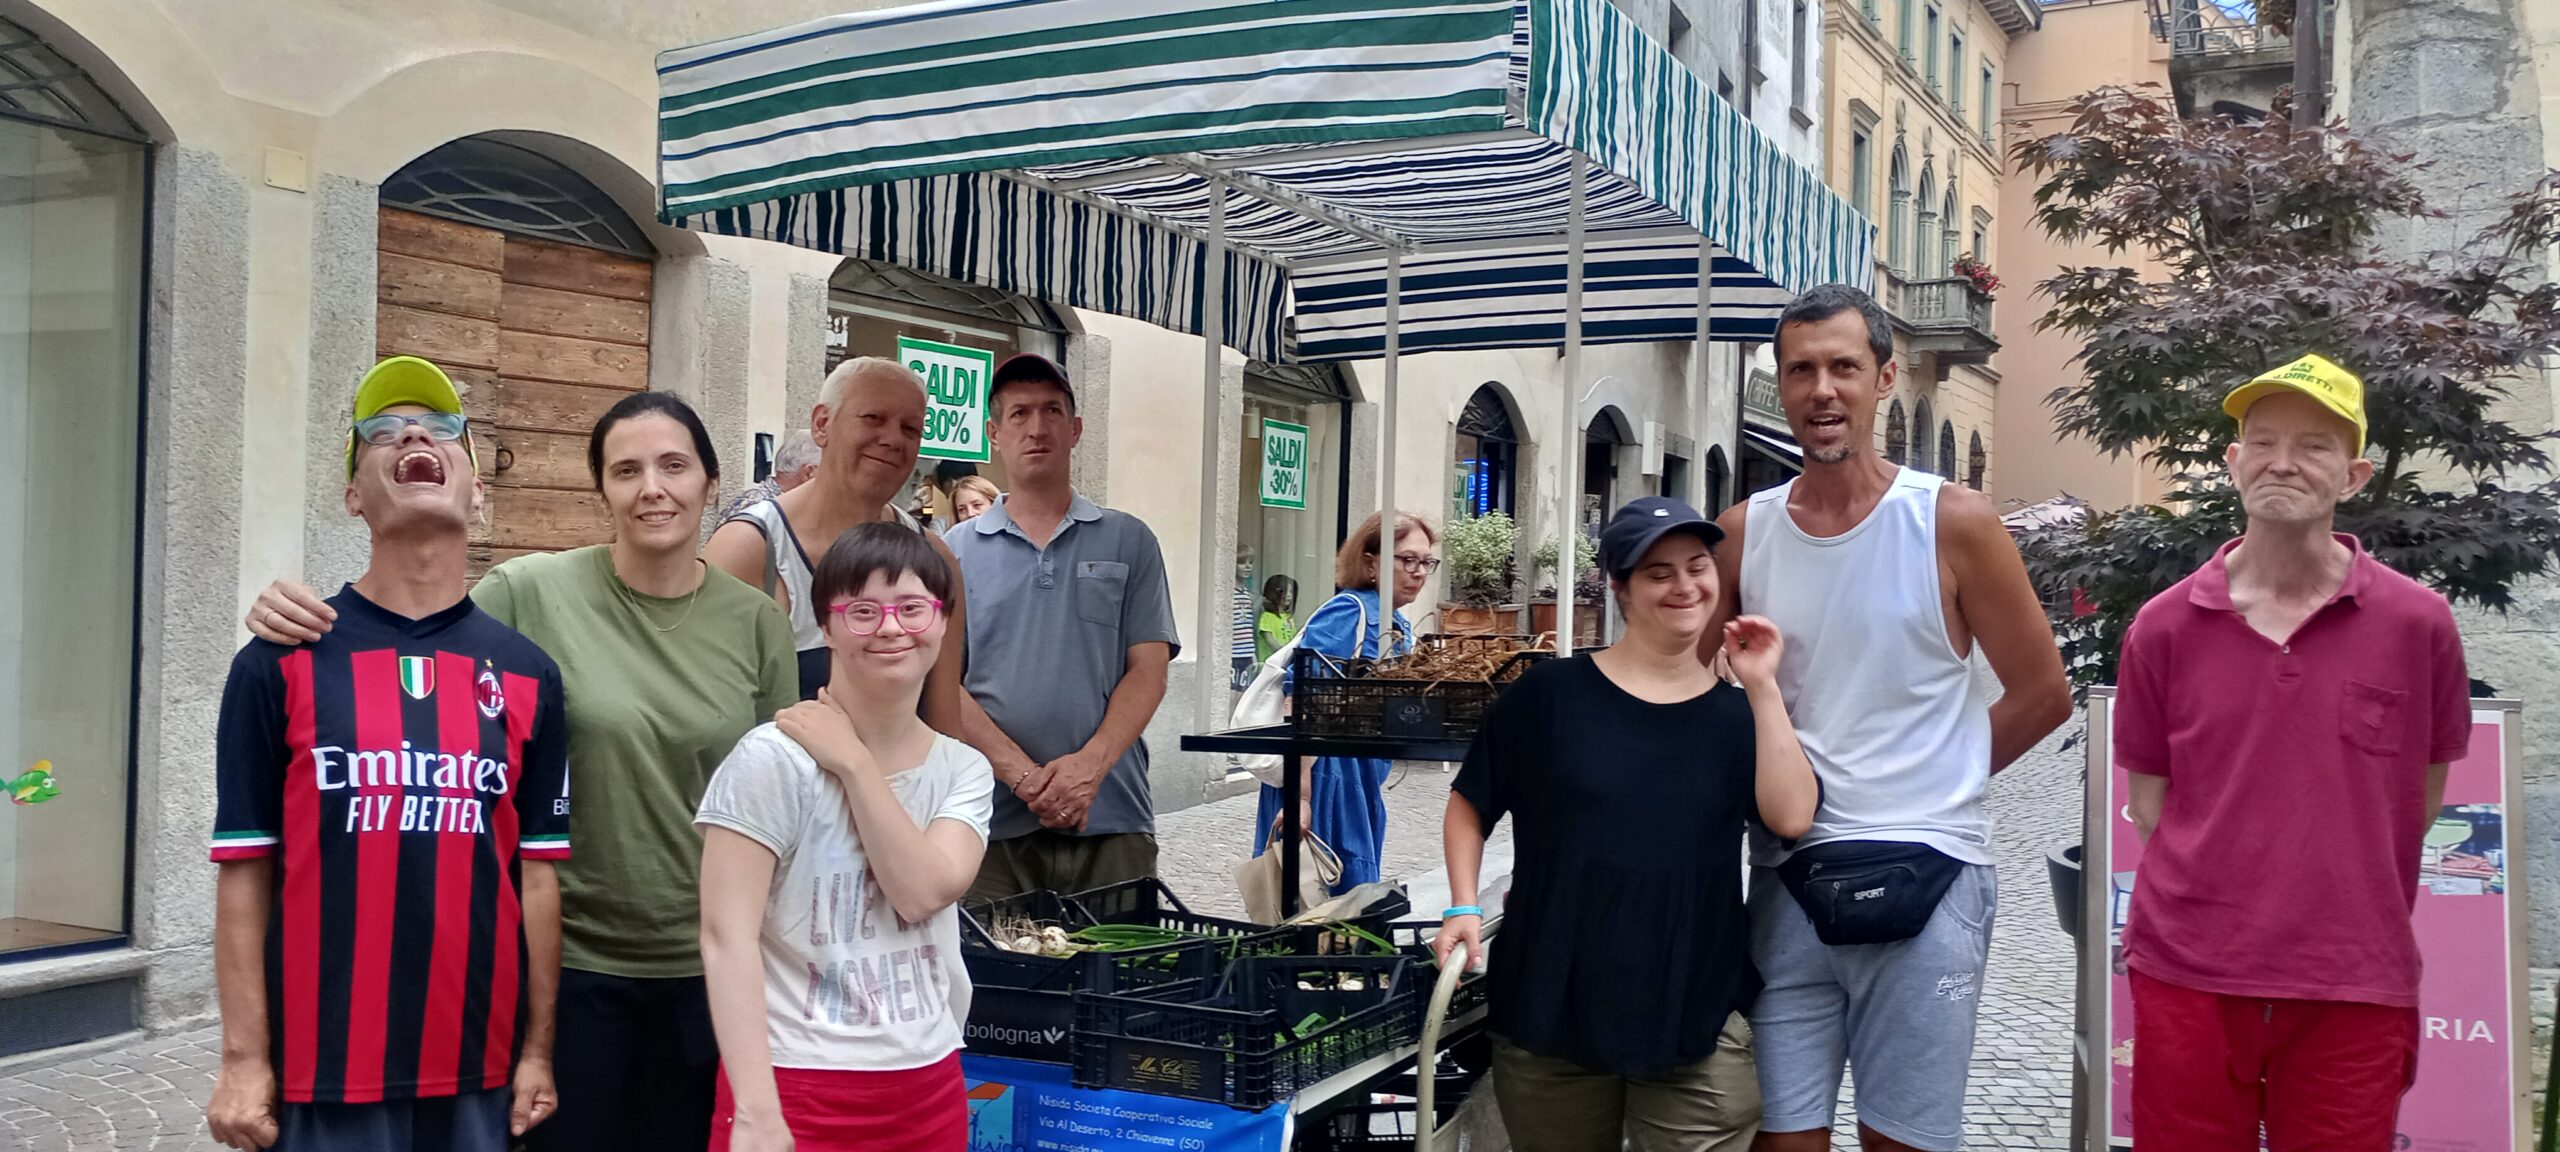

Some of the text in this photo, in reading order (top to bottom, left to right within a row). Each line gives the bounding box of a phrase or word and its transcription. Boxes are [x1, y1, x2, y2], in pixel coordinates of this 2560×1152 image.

[1268, 435, 1301, 469] SALDI
[1270, 469, 1298, 496] -30%
[311, 741, 508, 795] Emirates
[346, 795, 485, 834] FLY BETTER
[810, 868, 877, 947] LIVE
[1854, 887, 1885, 900] SPORT
[804, 944, 946, 1026] MOMENT
[966, 1021, 1042, 1045] bologna
[2424, 1016, 2495, 1043] RIA
[1039, 1095, 1071, 1110] Nisida
[1112, 1106, 1175, 1124] Cooperativa
[1177, 1115, 1214, 1131] Sociale
[1039, 1116, 1055, 1128] Via
[1069, 1121, 1114, 1139] Deserto,
[1115, 1128, 1123, 1139] 2
[1125, 1129, 1176, 1147] Chiavenna
[1178, 1136, 1206, 1152] (SO)
